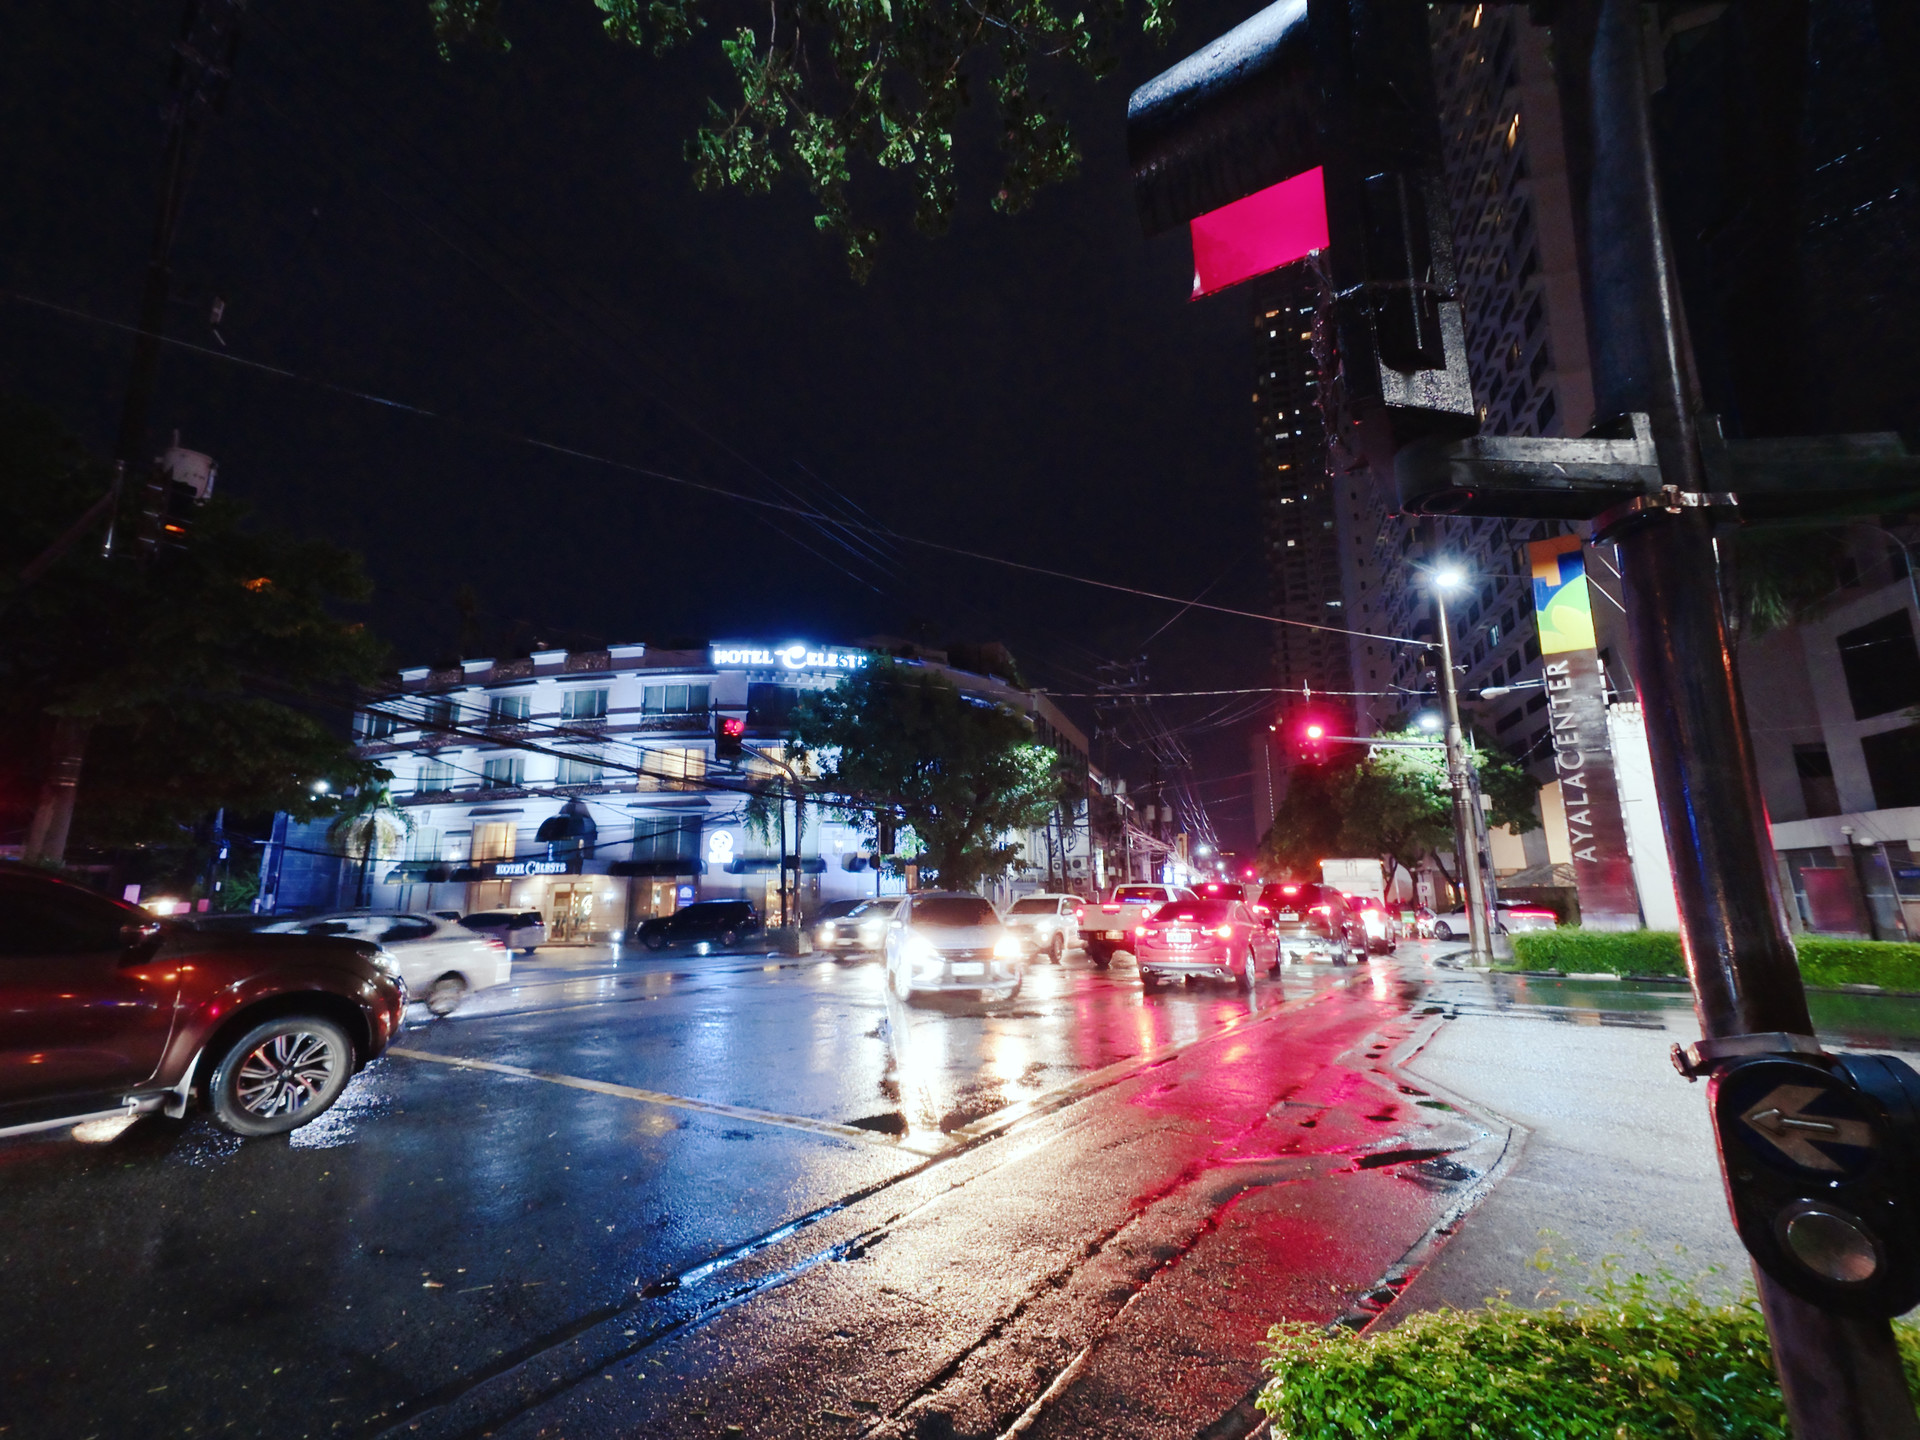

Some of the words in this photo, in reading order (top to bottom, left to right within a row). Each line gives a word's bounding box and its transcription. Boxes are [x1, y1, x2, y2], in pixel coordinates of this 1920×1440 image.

[714, 650, 773, 664] HOTEL
[495, 863, 524, 875] HOTEL
[525, 861, 567, 876] CELESTE
